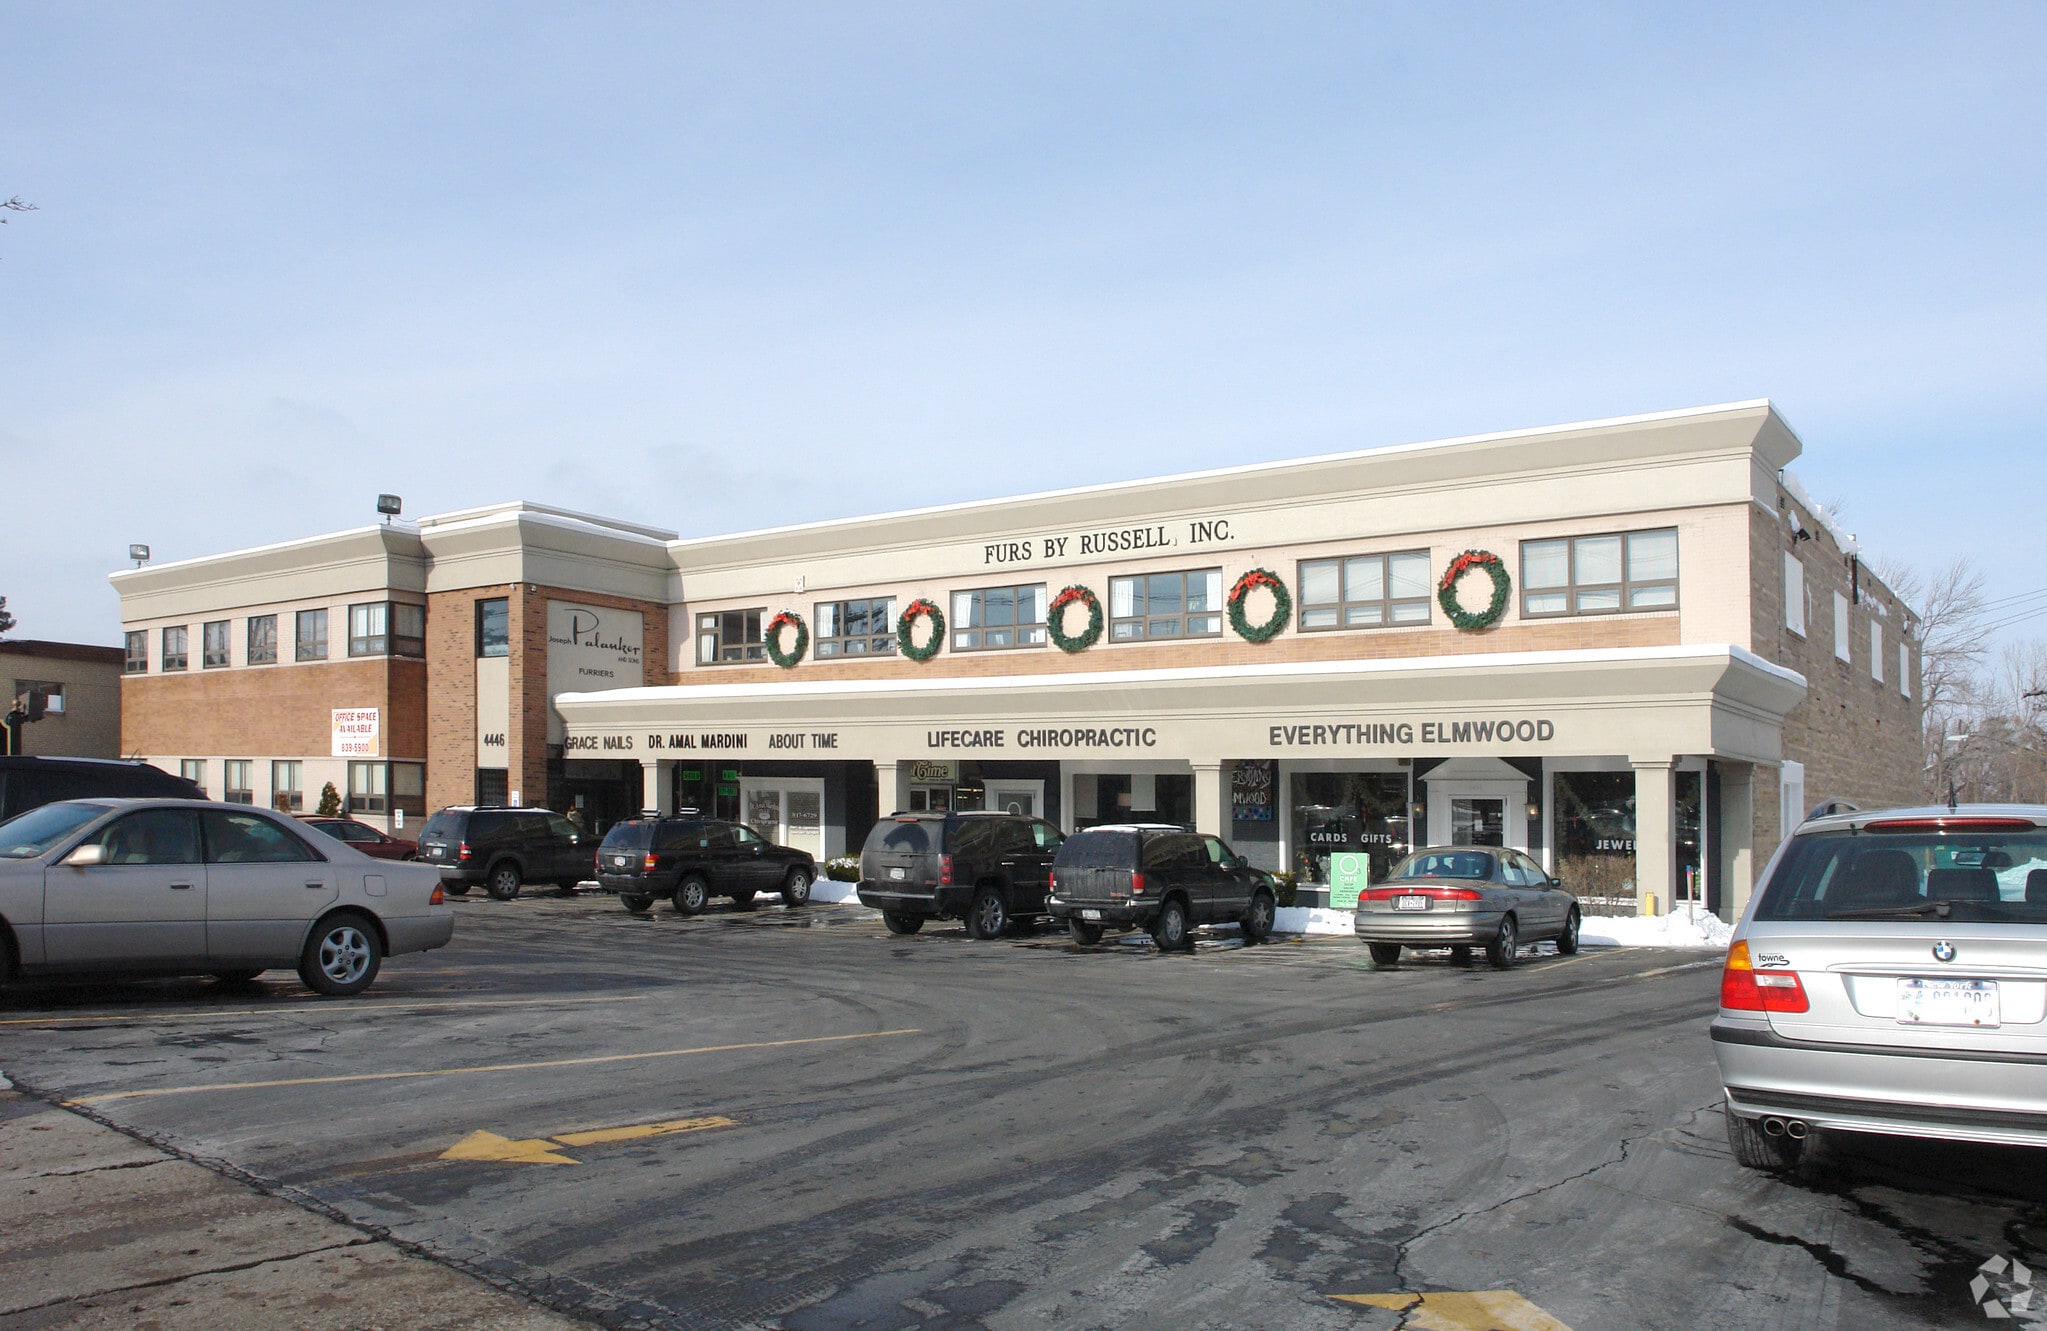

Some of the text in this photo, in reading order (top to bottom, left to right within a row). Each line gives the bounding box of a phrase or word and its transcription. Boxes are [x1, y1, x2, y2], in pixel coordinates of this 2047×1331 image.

[984, 541, 1032, 564] FURS
[1043, 536, 1069, 558] BY
[1189, 519, 1235, 544] INC.
[563, 608, 640, 655] Palanker
[578, 667, 615, 678] FURRIERS
[335, 712, 377, 722] OFFICE SPACE
[339, 724, 372, 733] AVAILABLE
[1269, 719, 1555, 746] EVERYTHING ELMWOOD
[483, 733, 505, 747] 4446
[564, 735, 633, 750] GRACE NAILS
[648, 733, 748, 749] DR. AMAL MARDINI
[768, 733, 838, 749] ABOUT TIME
[927, 728, 1157, 748] LIFECARE CHIROPRACTIC
[341, 743, 369, 753] 839-5900
[1310, 832, 1392, 844] CARDS GIFTS
[1758, 952, 1785, 962] towne
